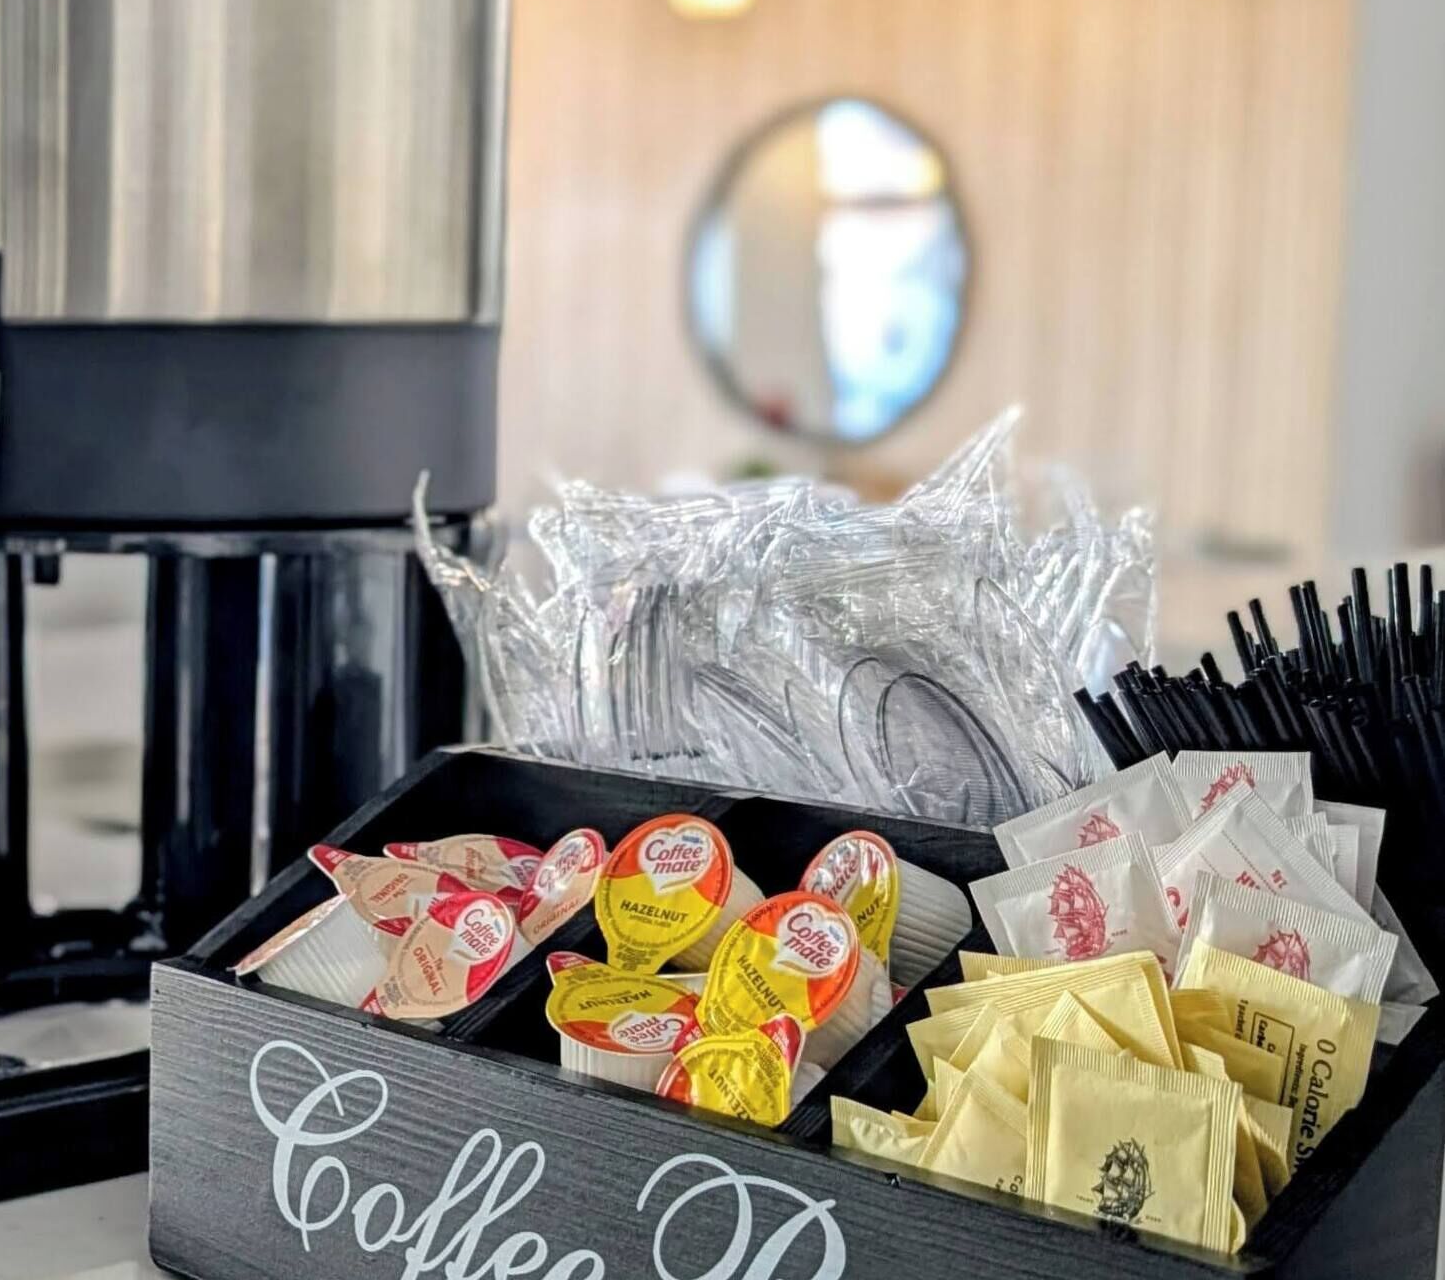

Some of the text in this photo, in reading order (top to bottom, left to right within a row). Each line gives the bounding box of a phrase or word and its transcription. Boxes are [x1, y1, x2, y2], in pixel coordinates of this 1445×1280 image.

[645, 839, 704, 862] Coffee
[652, 860, 702, 875] mate
[620, 899, 689, 924] HAZELNUT
[463, 909, 500, 947] Coffee
[787, 912, 840, 957] Coffee
[459, 929, 490, 956] mate
[784, 936, 832, 969] mate
[413, 946, 442, 996] ORIGINAL
[737, 954, 787, 1013] HAZELNUT
[579, 989, 653, 1010] HAZELNUT
[618, 1016, 662, 1038] mate
[628, 1018, 685, 1044] Coffee
[1316, 1038, 1337, 1055] 0
[1300, 1059, 1333, 1140] Calorie
